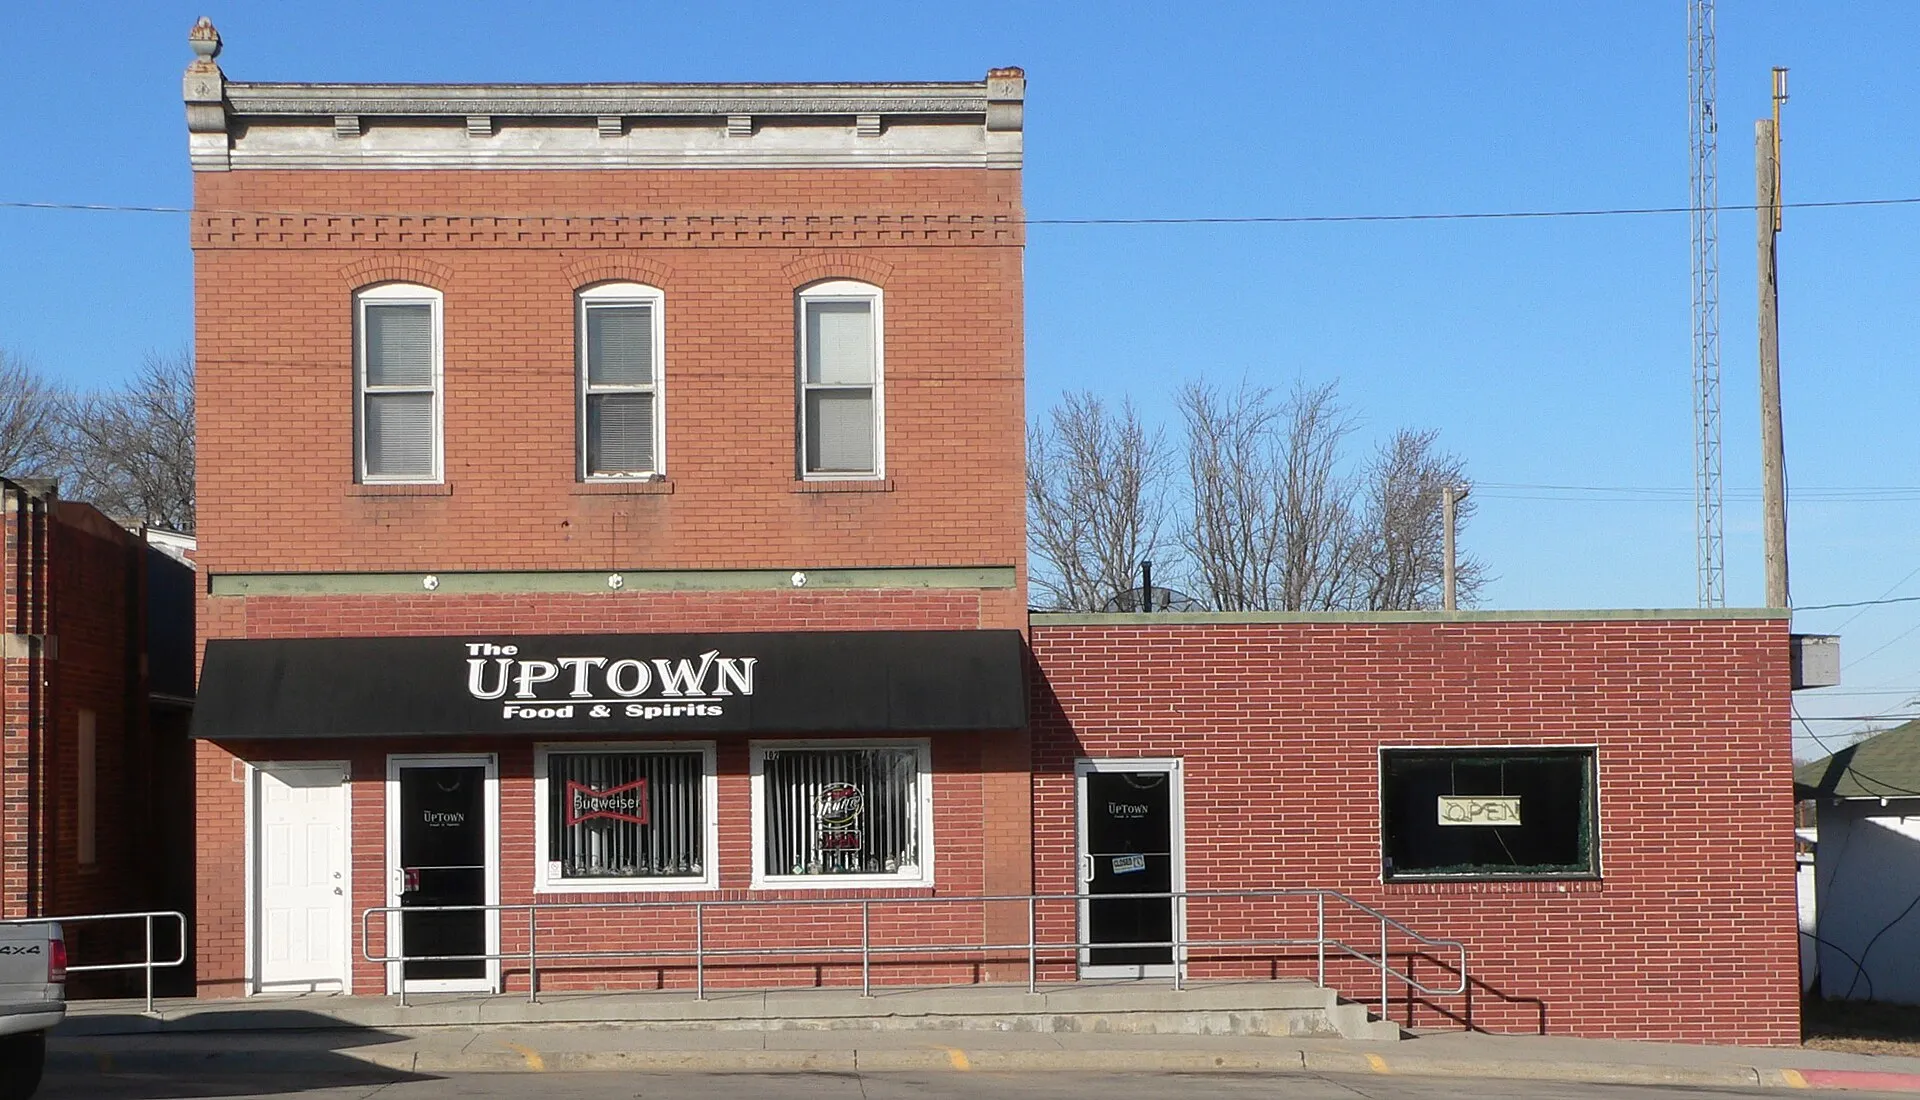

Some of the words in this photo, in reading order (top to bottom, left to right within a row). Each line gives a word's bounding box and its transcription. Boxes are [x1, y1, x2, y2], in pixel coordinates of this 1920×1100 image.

[465, 643, 518, 656] The
[466, 649, 758, 700] UPTOWN
[503, 705, 574, 719] Food
[589, 704, 611, 718] &
[625, 704, 723, 720] Spirits
[574, 796, 640, 811] Budweiser
[1108, 804, 1149, 814] UPTOWN
[423, 812, 465, 822] UPTOWN
[1443, 801, 1520, 822] OPEN
